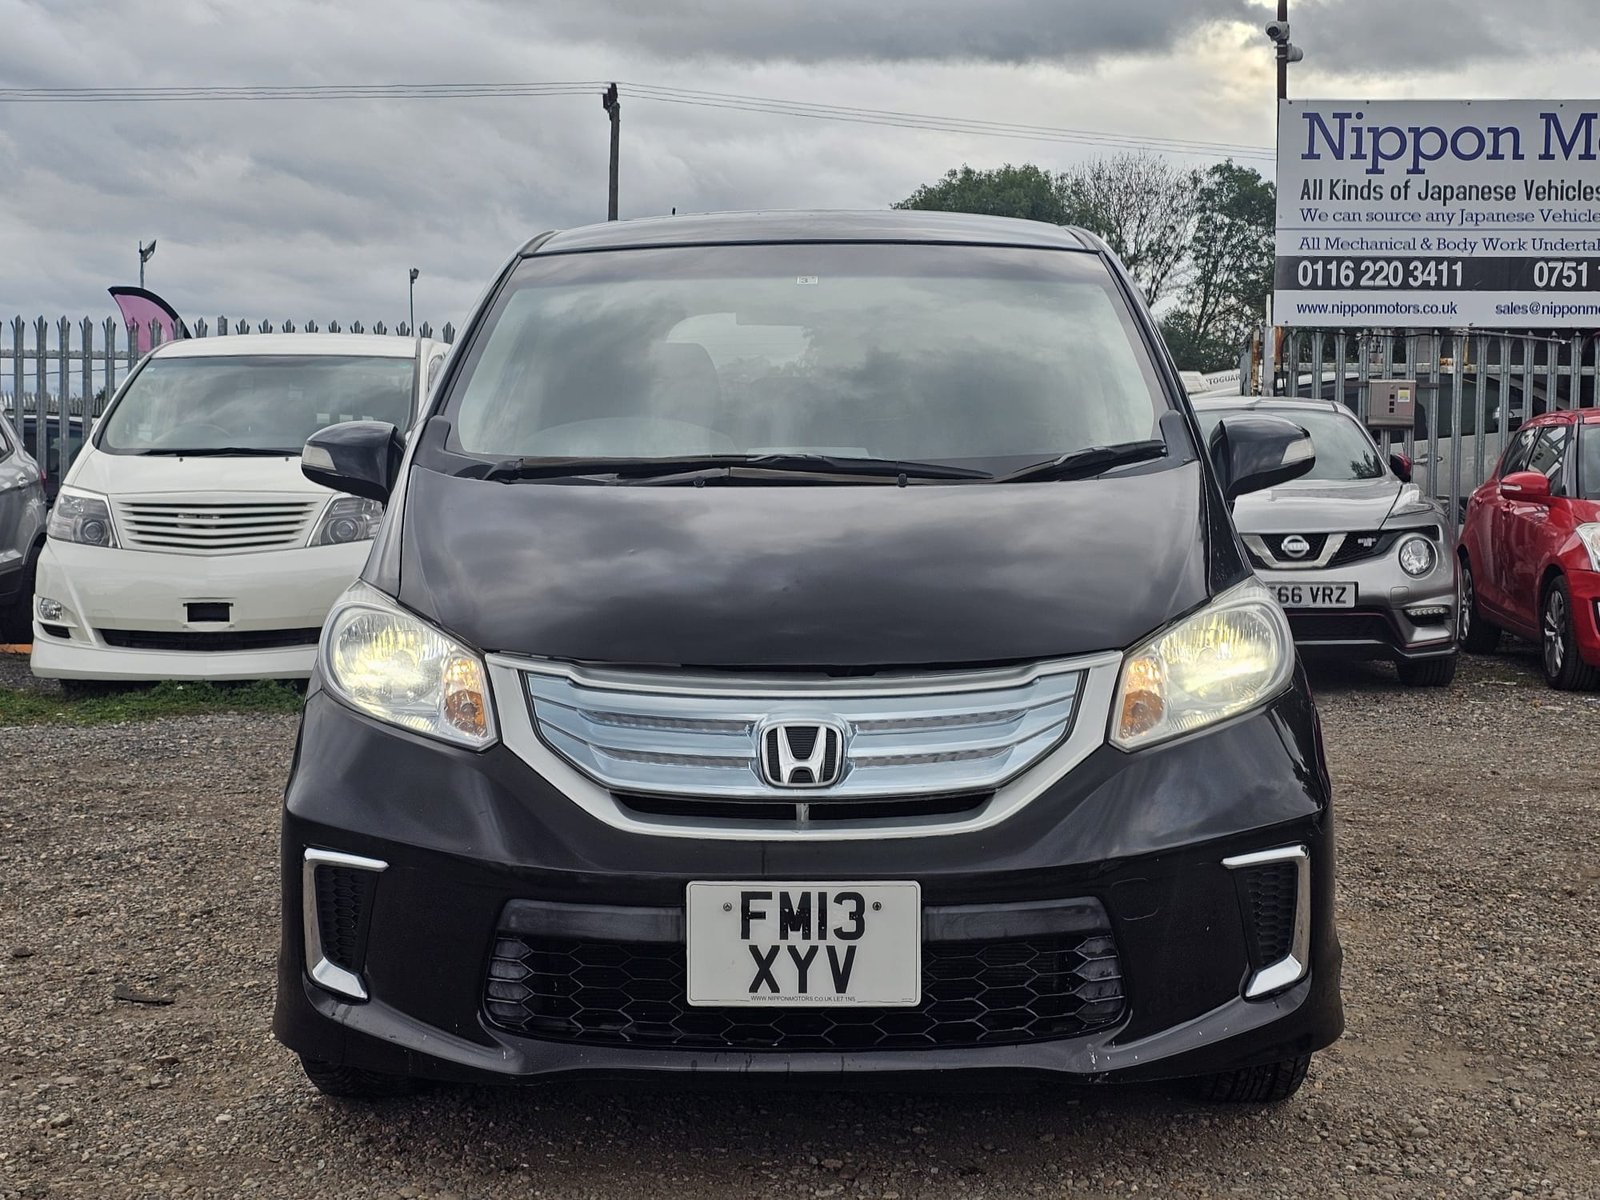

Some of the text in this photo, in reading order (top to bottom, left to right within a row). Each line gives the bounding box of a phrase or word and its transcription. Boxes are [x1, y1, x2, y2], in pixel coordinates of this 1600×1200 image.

[1301, 112, 1600, 174] Nippon M
[1300, 179, 1323, 201] All
[1329, 179, 1384, 201] Kinds
[1390, 179, 1410, 201] of
[1418, 179, 1516, 206] Japanese
[1299, 208, 1600, 226] We can source any Japanese Vehicle
[1298, 237, 1321, 251] All
[1324, 237, 1417, 251] Mechanical
[1420, 237, 1433, 251] &
[1437, 238, 1478, 255] Body
[1481, 238, 1528, 251] Work
[1298, 260, 1463, 287] 0116 220 3411
[1533, 261, 1588, 288] 0751
[1297, 301, 1457, 317] www.nipponmotors.co.uk
[1495, 301, 1600, 318] sales@nipponm
[1310, 586, 1347, 604] VRZ
[740, 891, 866, 940] FM13
[748, 945, 857, 993] XYV
